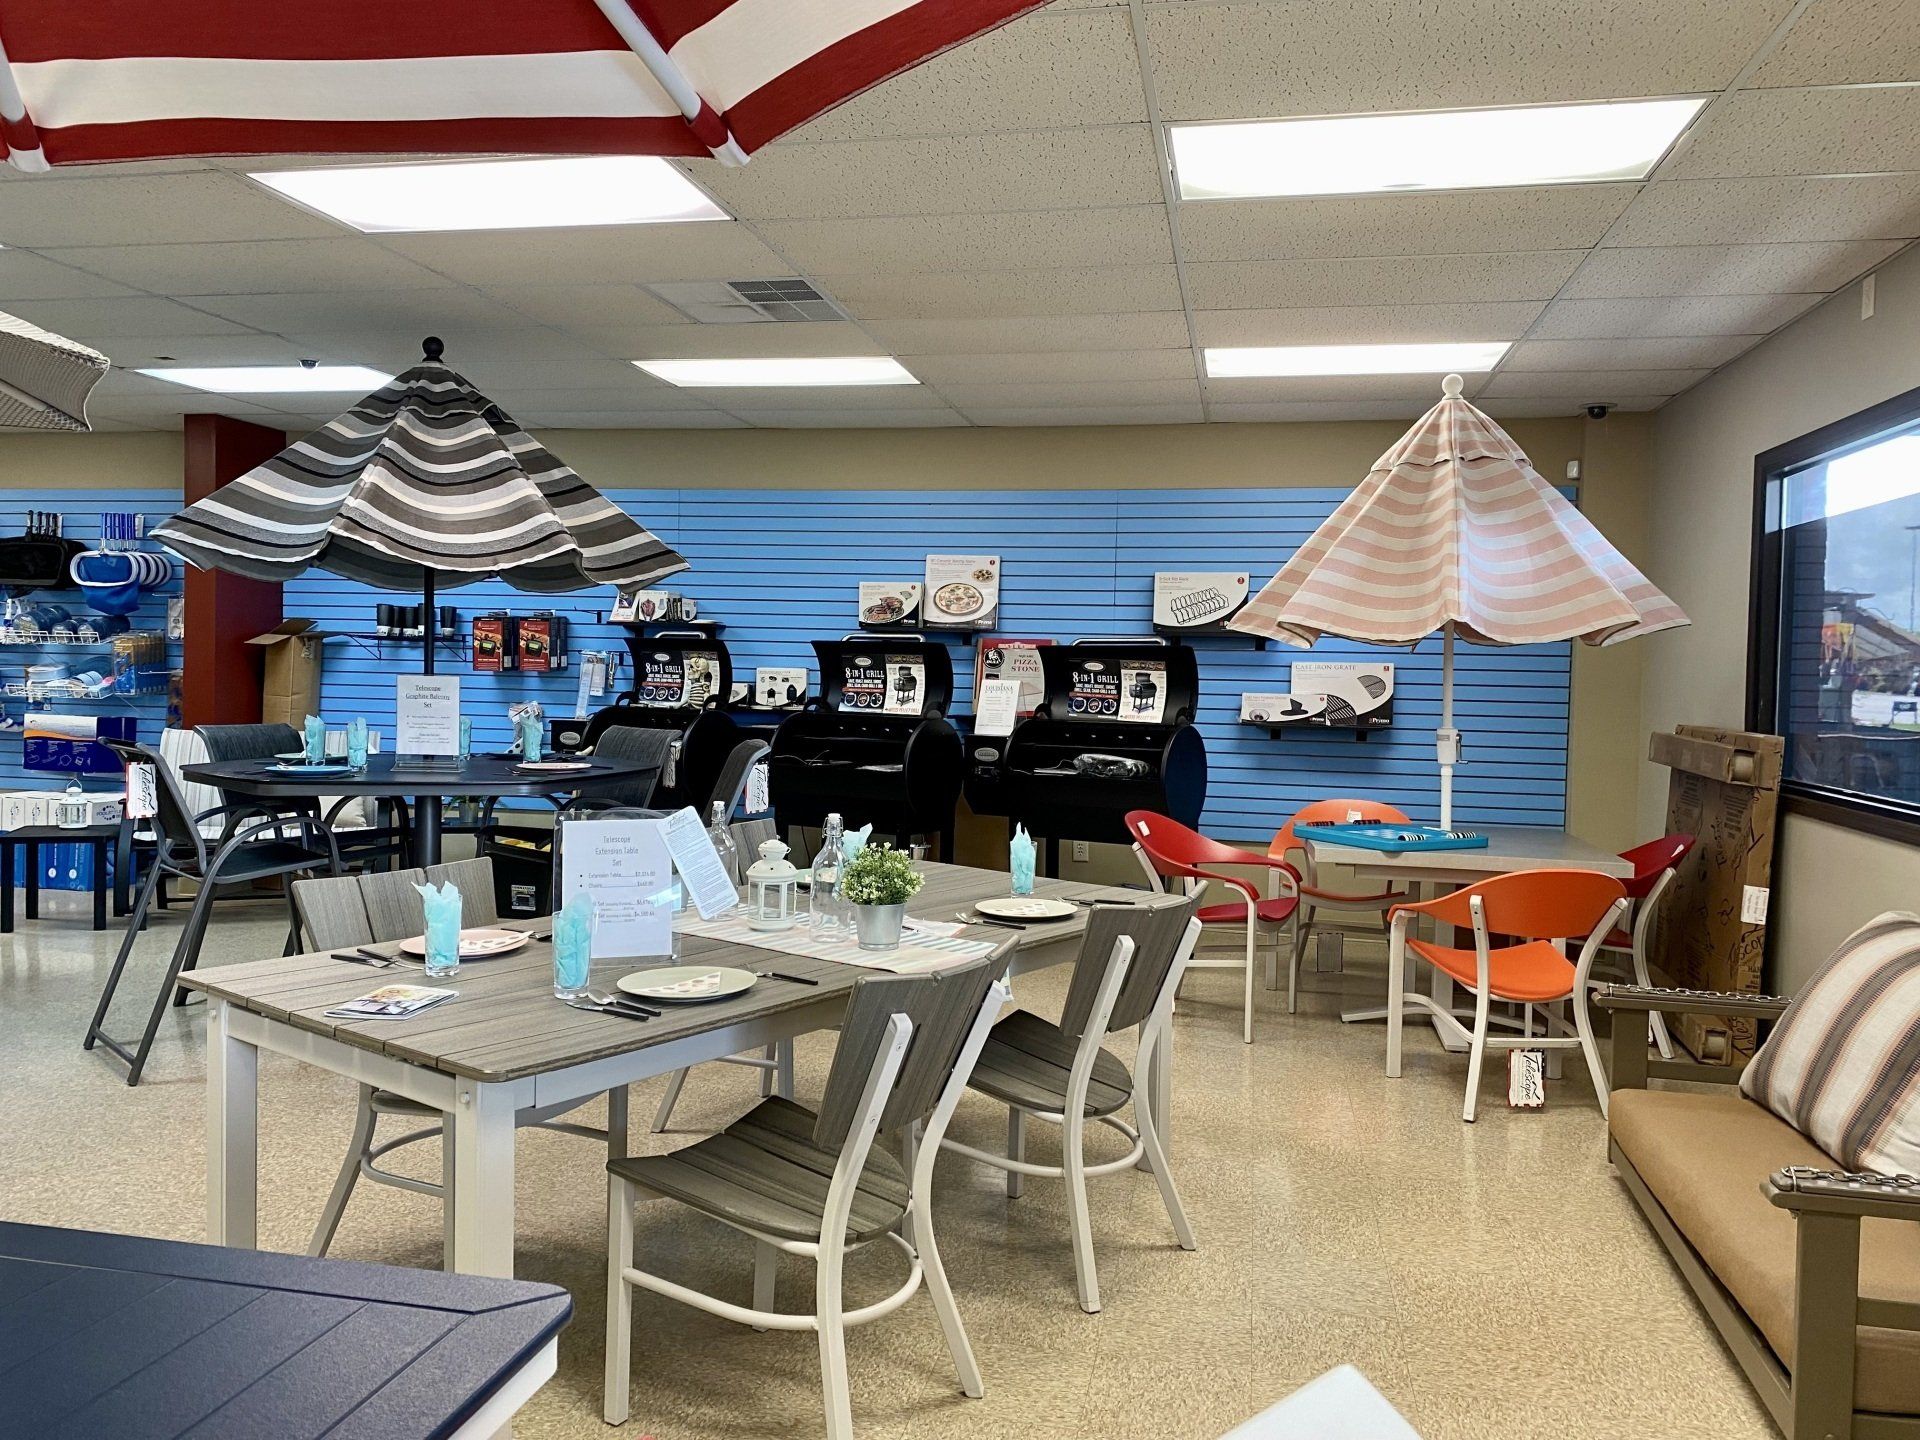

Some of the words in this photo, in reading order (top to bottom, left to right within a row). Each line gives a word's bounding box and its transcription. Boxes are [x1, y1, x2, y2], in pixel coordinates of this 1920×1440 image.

[645, 662, 663, 674] 8-IN-1
[845, 667, 865, 679] 8-IN-1
[1072, 671, 1095, 684] 8-IN-1
[1097, 675, 1119, 684] GRILL
[603, 835, 631, 844] Telescope
[595, 847, 623, 855] Extension
[1520, 1055, 1541, 1101] Telescope
